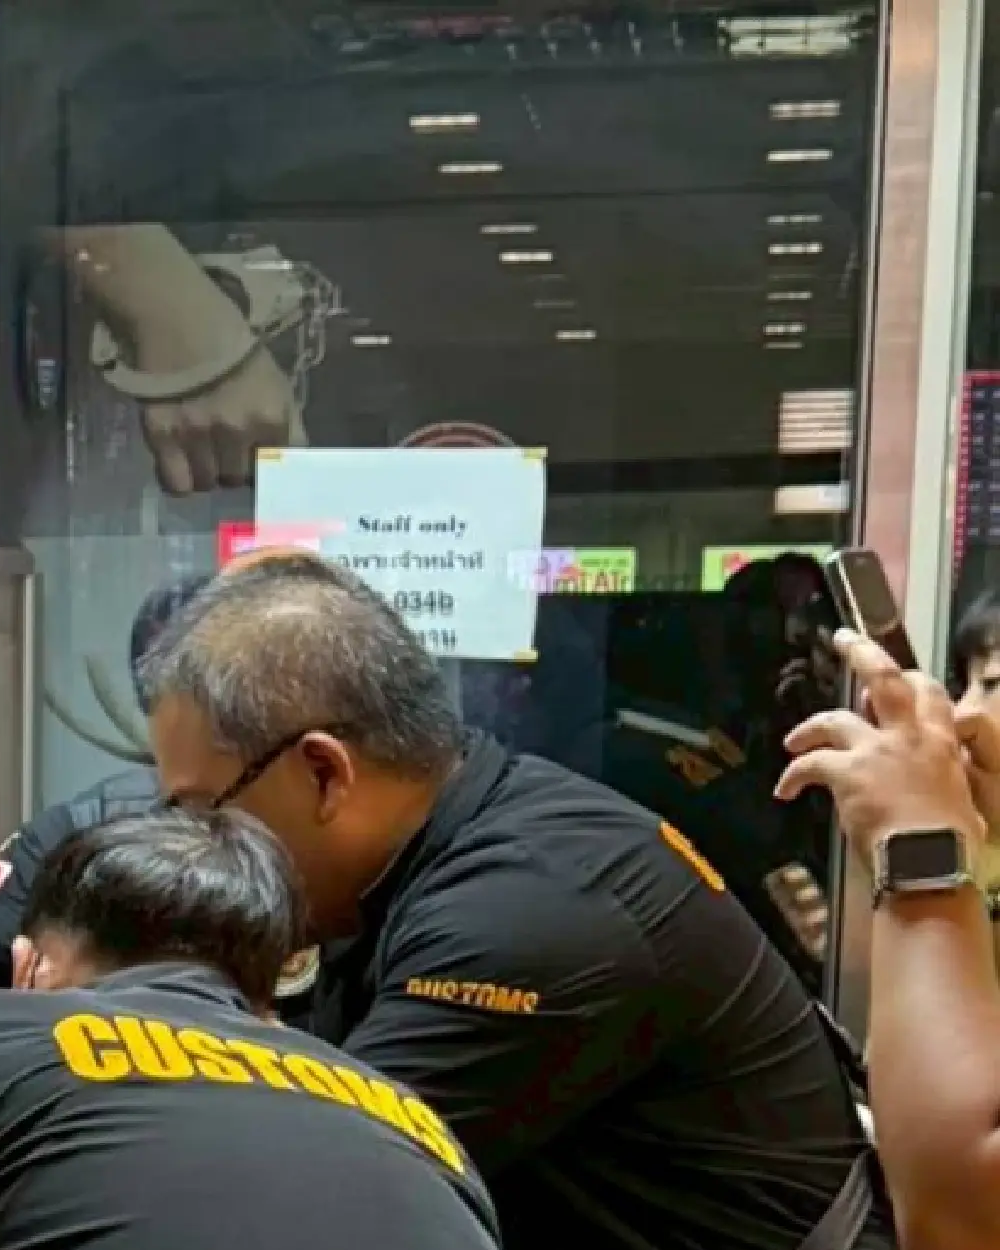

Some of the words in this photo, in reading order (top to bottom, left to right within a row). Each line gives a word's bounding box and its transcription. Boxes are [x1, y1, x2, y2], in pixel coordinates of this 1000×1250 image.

[357, 514, 411, 533] Staff
[418, 514, 468, 540] only
[405, 978, 540, 1015] CUSTOMS
[53, 1014, 467, 1177] CUSTOMS
